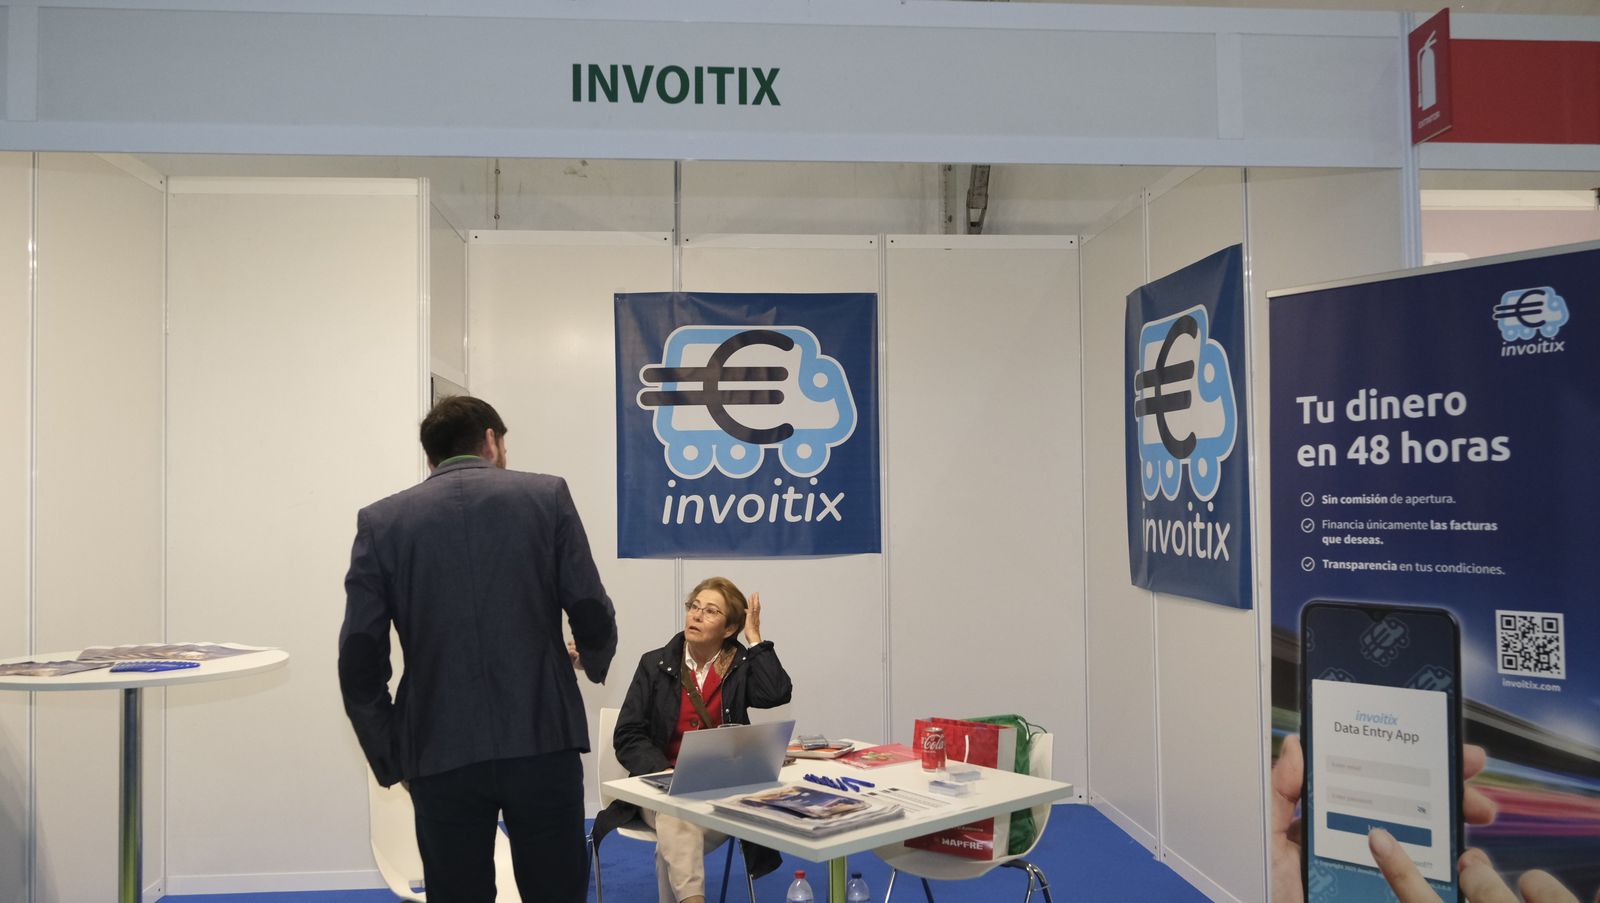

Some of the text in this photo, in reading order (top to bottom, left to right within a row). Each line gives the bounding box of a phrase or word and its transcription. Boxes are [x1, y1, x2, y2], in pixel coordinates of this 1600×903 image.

[572, 63, 781, 106] INVOITIX
[1501, 336, 1565, 357] invoitix
[1296, 388, 1467, 424] Tu dinero
[1297, 431, 1511, 467] en 48 horas
[662, 477, 845, 525] invoitix
[1322, 493, 1456, 506] Sin comisión de apertura.
[1322, 519, 1498, 531] Financia únicamente las facturas
[1322, 534, 1384, 546] que deseas.
[1322, 559, 1506, 575] Transparencia en tus condiciones.
[1502, 677, 1561, 692] invoitix.com
[1356, 710, 1398, 725] invoitix
[1334, 721, 1420, 744] Data Entry App
[941, 838, 983, 850] MAPFRE
